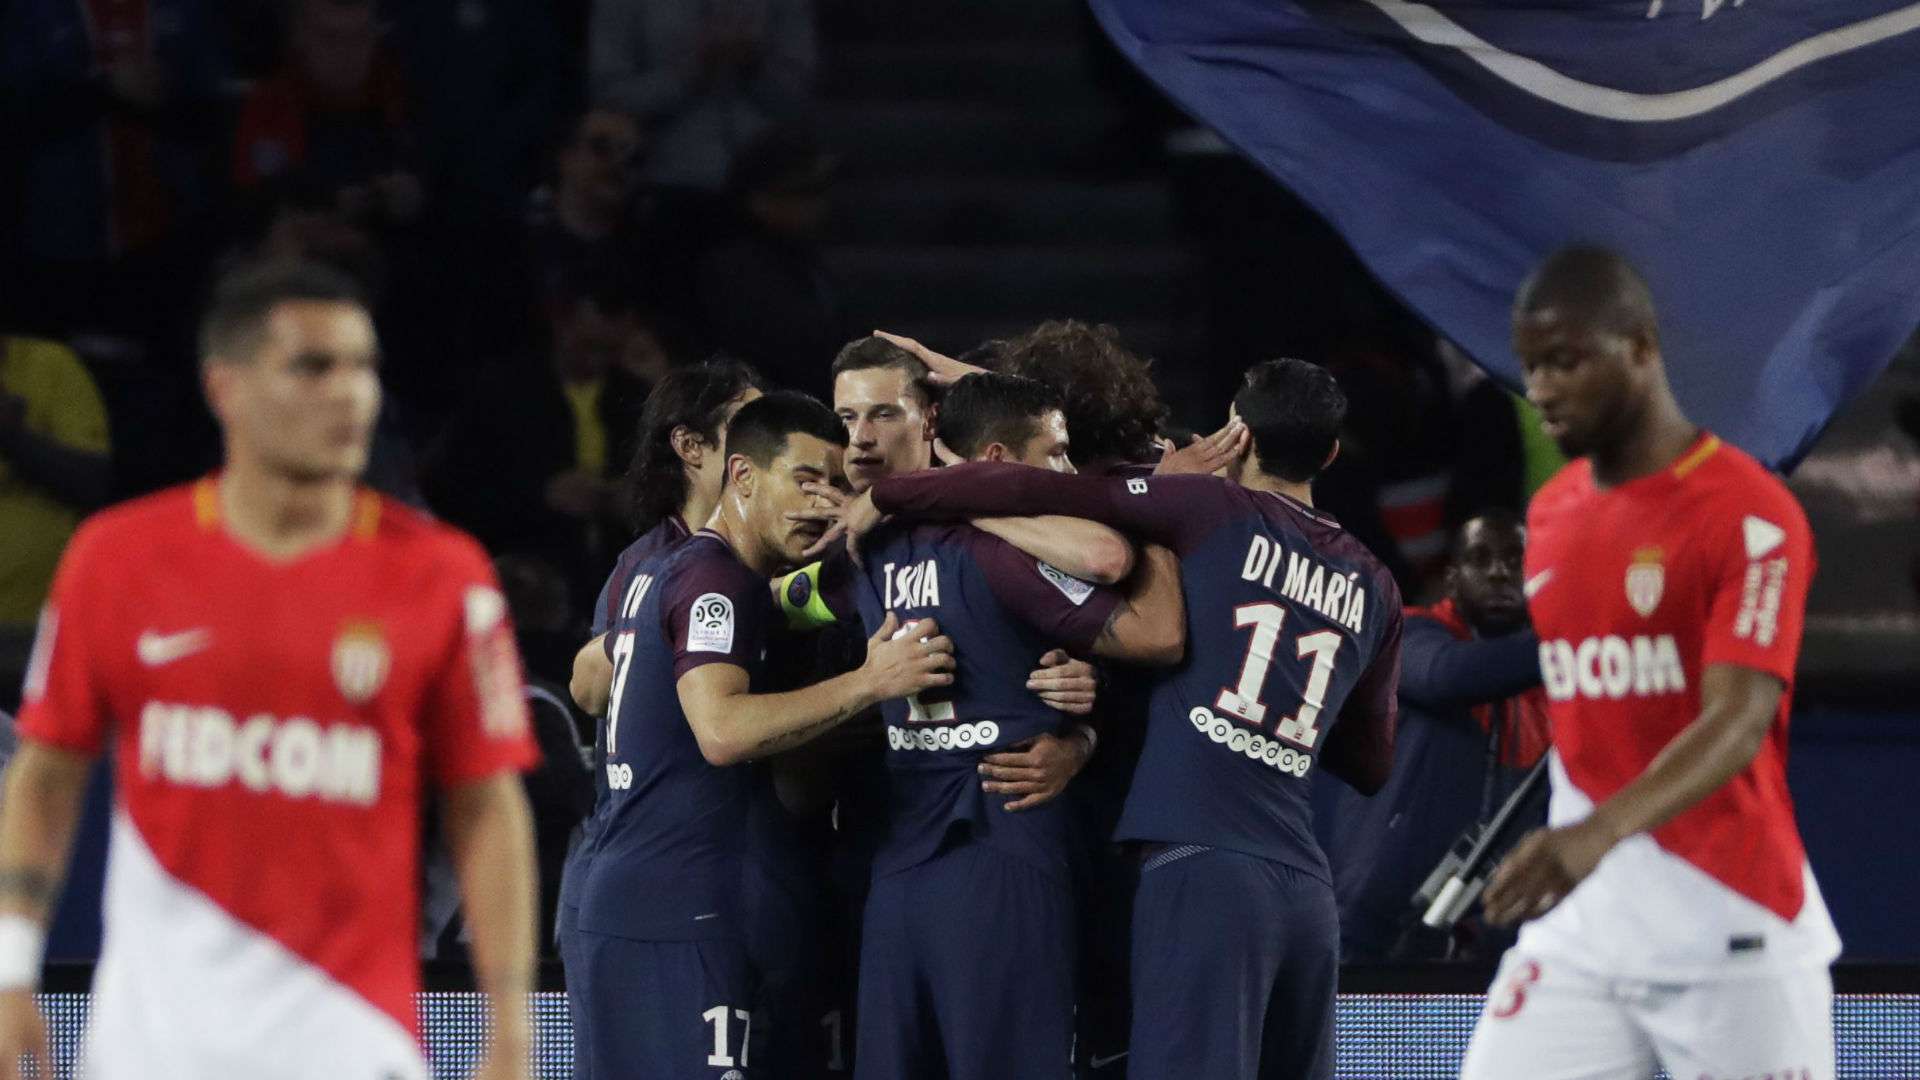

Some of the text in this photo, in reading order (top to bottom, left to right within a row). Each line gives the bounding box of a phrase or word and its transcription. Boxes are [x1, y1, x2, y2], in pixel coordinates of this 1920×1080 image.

[1241, 534, 1365, 634] DI MARÍA
[1213, 600, 1344, 751] 11
[1188, 705, 1312, 778] ooredoo
[702, 1005, 750, 1067] 17
